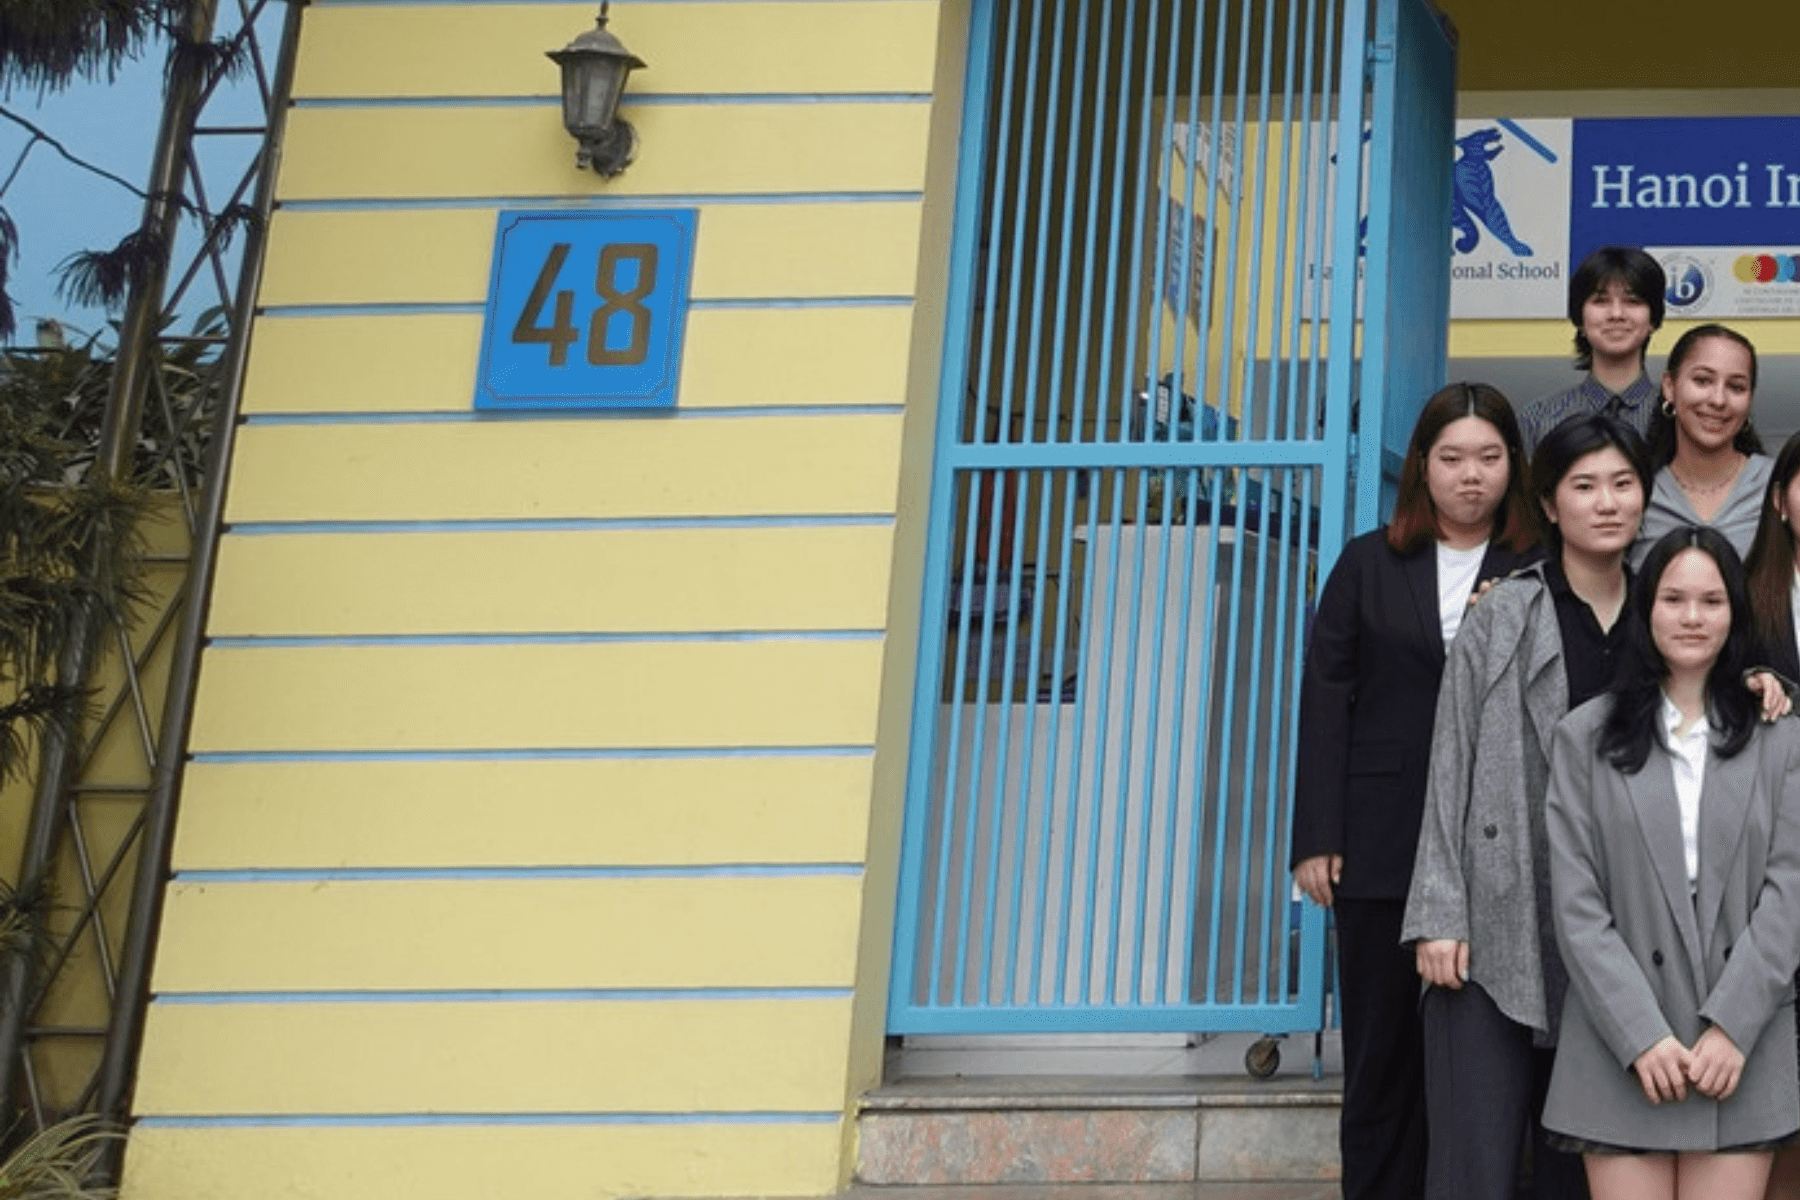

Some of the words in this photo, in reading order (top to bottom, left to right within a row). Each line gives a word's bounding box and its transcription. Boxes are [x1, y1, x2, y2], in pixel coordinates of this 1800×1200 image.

[1591, 161, 1752, 209] Hanoi
[1497, 261, 1560, 280] School
[511, 243, 658, 366] 48
